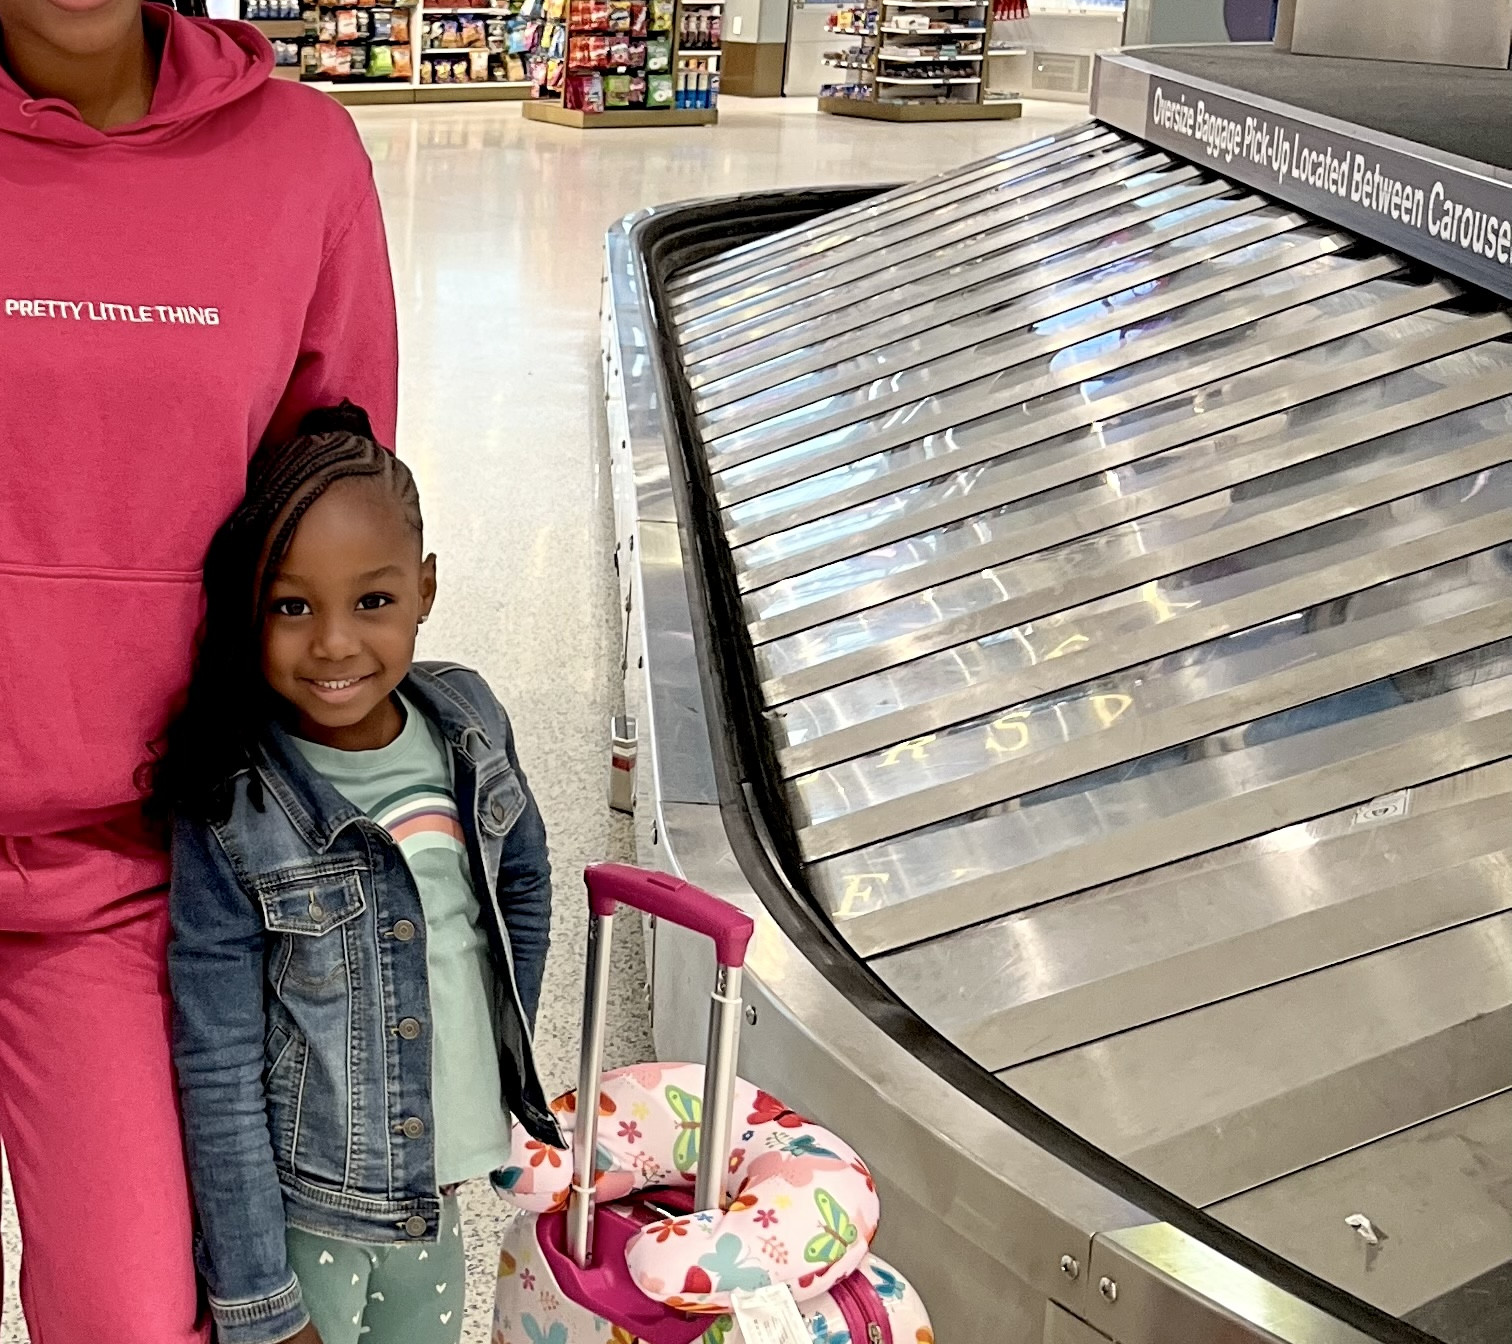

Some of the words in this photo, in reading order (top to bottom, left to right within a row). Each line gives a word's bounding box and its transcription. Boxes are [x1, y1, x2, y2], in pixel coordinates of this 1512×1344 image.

[1153, 86, 1194, 137] Oversize
[1194, 100, 1242, 162] Baggage
[1242, 116, 1291, 184] Pick-Up
[1291, 132, 1350, 198] Located
[1352, 154, 1424, 228] Between
[5, 298, 83, 321] PRETTY
[85, 301, 154, 323] LITTLE
[154, 305, 220, 325] THING
